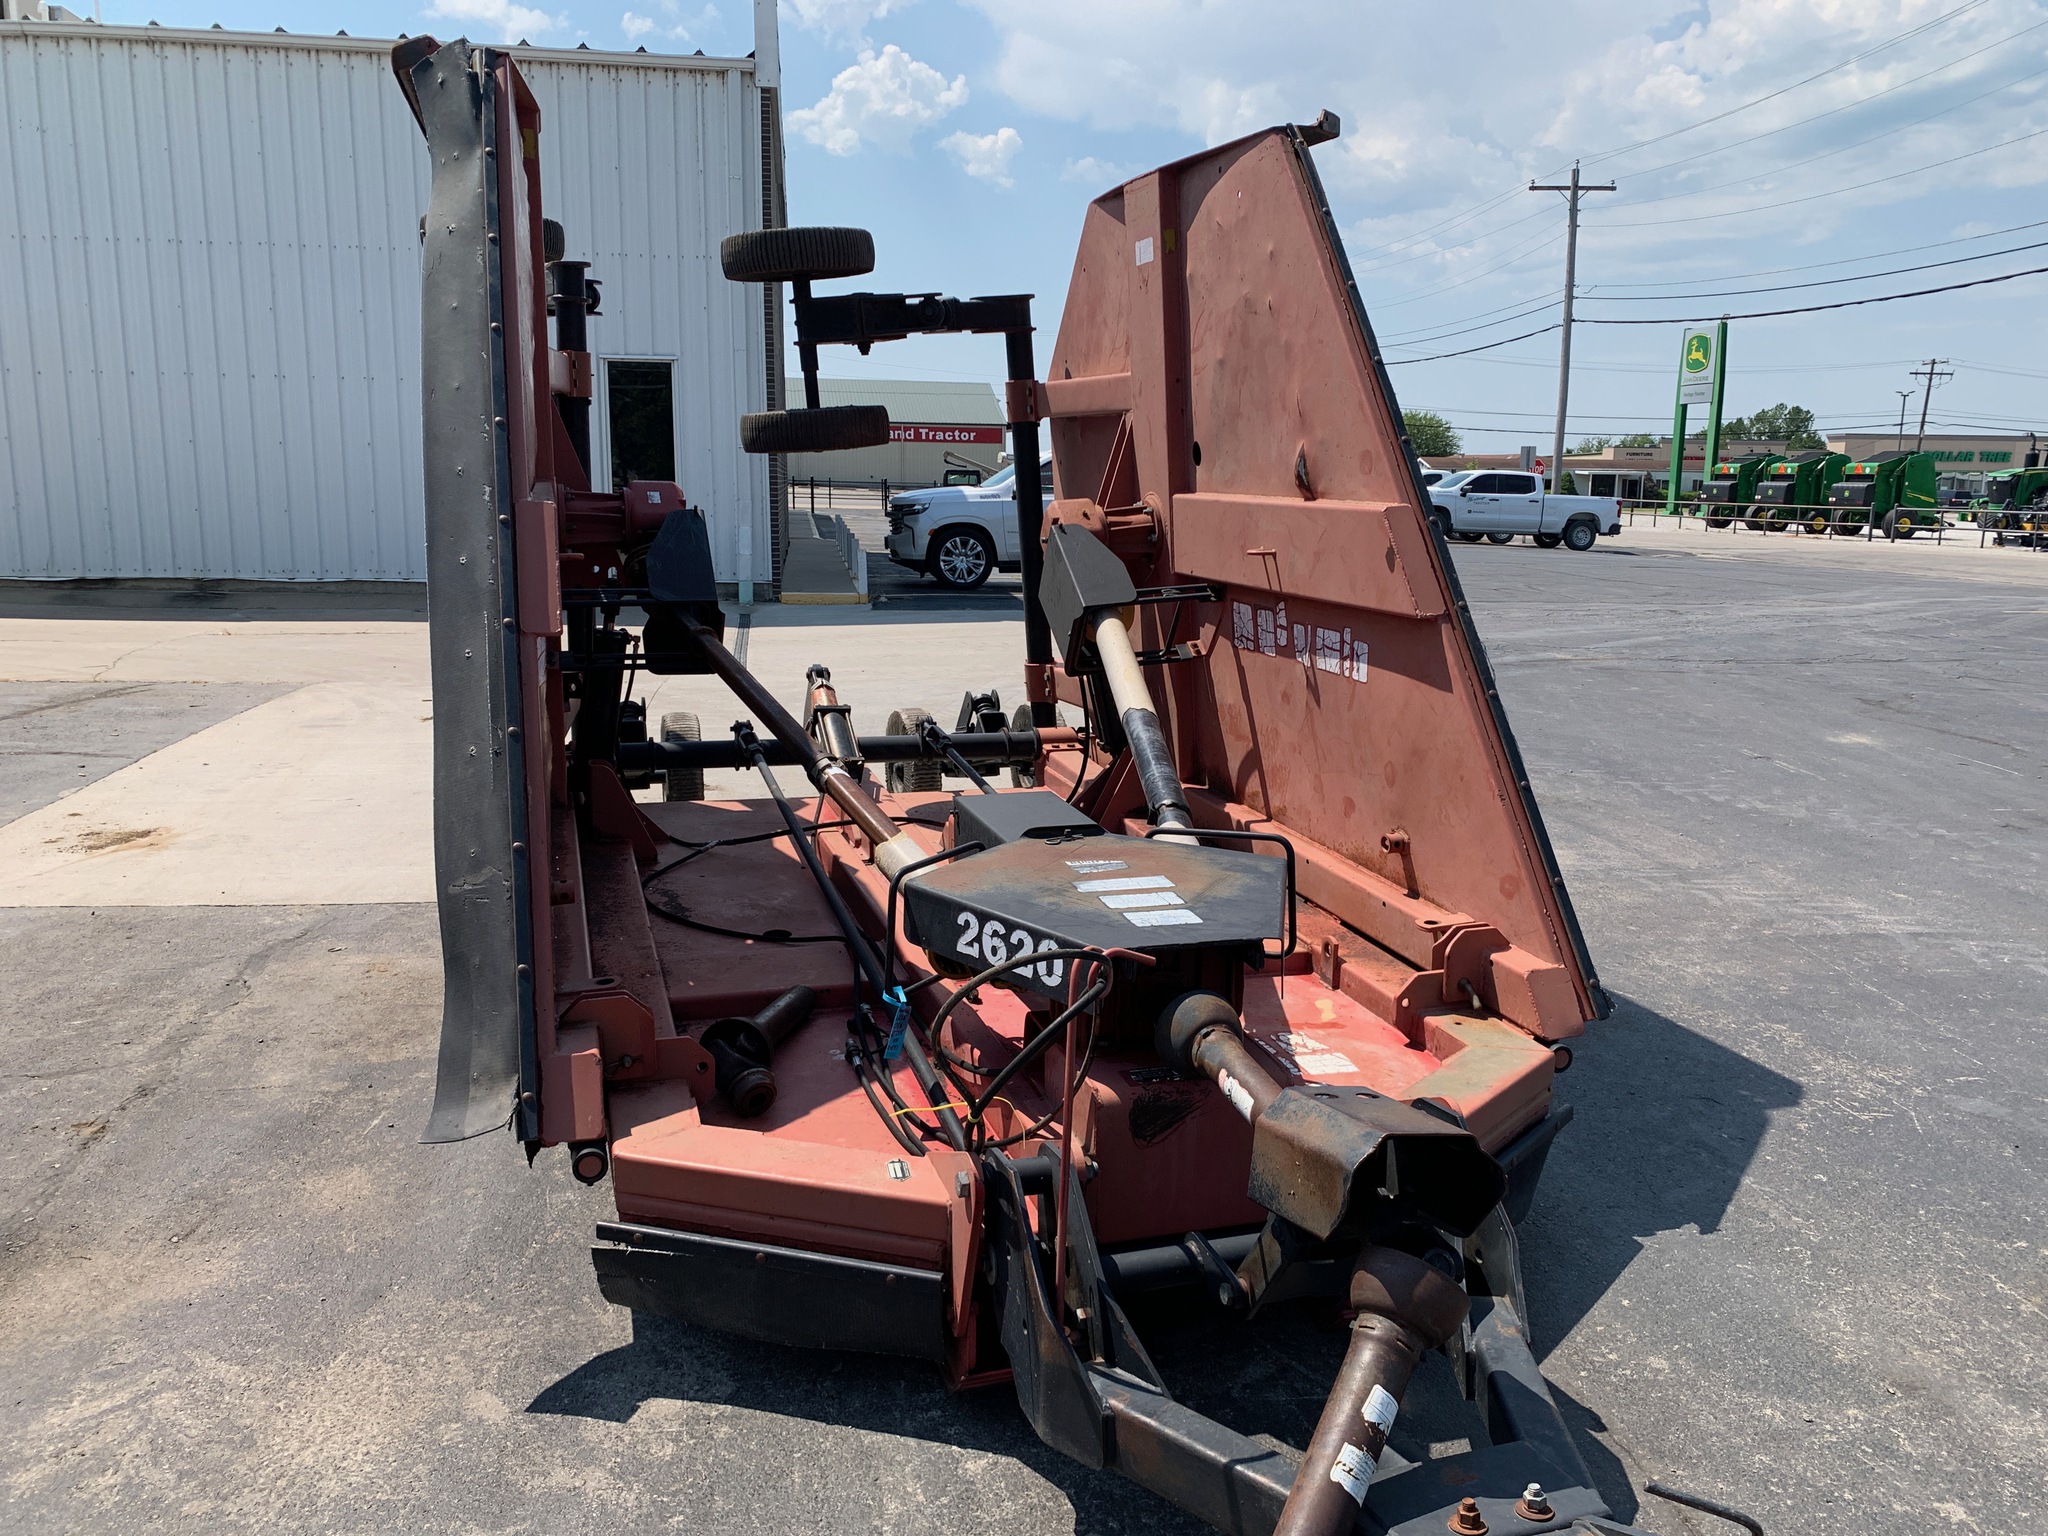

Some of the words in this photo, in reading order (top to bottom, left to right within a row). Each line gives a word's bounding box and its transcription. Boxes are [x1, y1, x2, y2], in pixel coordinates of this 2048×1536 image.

[919, 428, 976, 441] Tractor
[1980, 451, 2012, 462] TREE
[956, 911, 1064, 987] 2620
